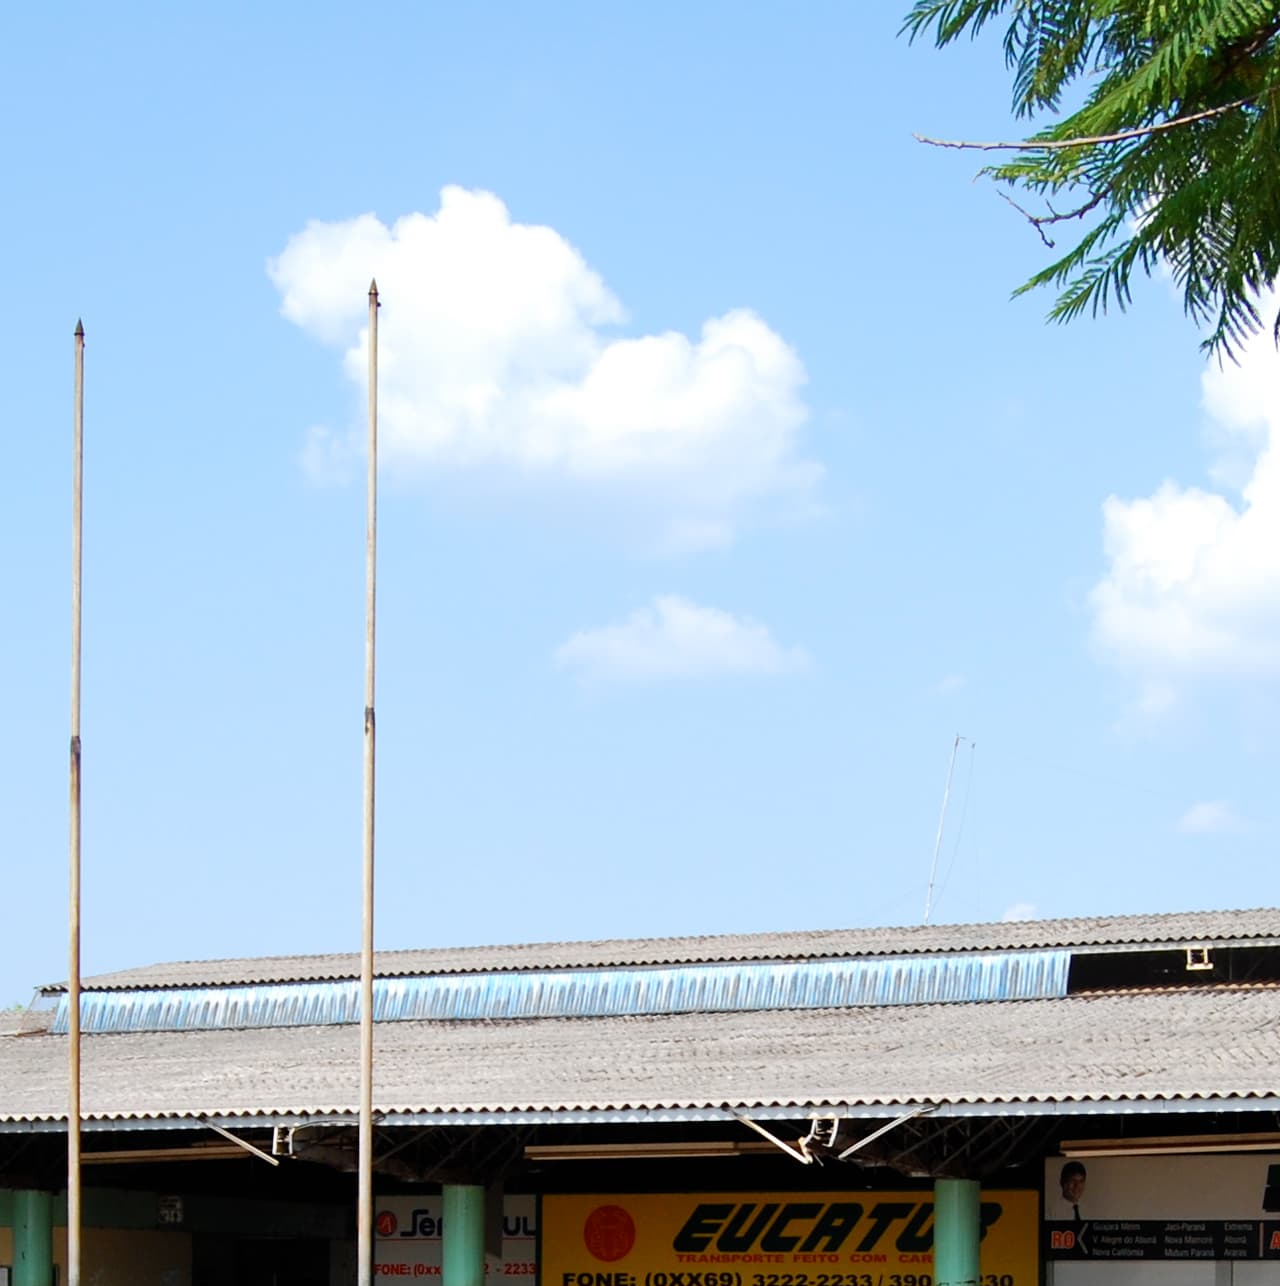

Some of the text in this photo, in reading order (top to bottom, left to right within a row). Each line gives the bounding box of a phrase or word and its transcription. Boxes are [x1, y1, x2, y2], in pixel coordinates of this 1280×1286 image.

[1050, 1230, 1076, 1249] RO
[675, 1254, 785, 1264] TRANSPORTE
[792, 1253, 840, 1264] FEITO
[849, 1253, 888, 1264] COM
[504, 1263, 538, 1276] 2233
